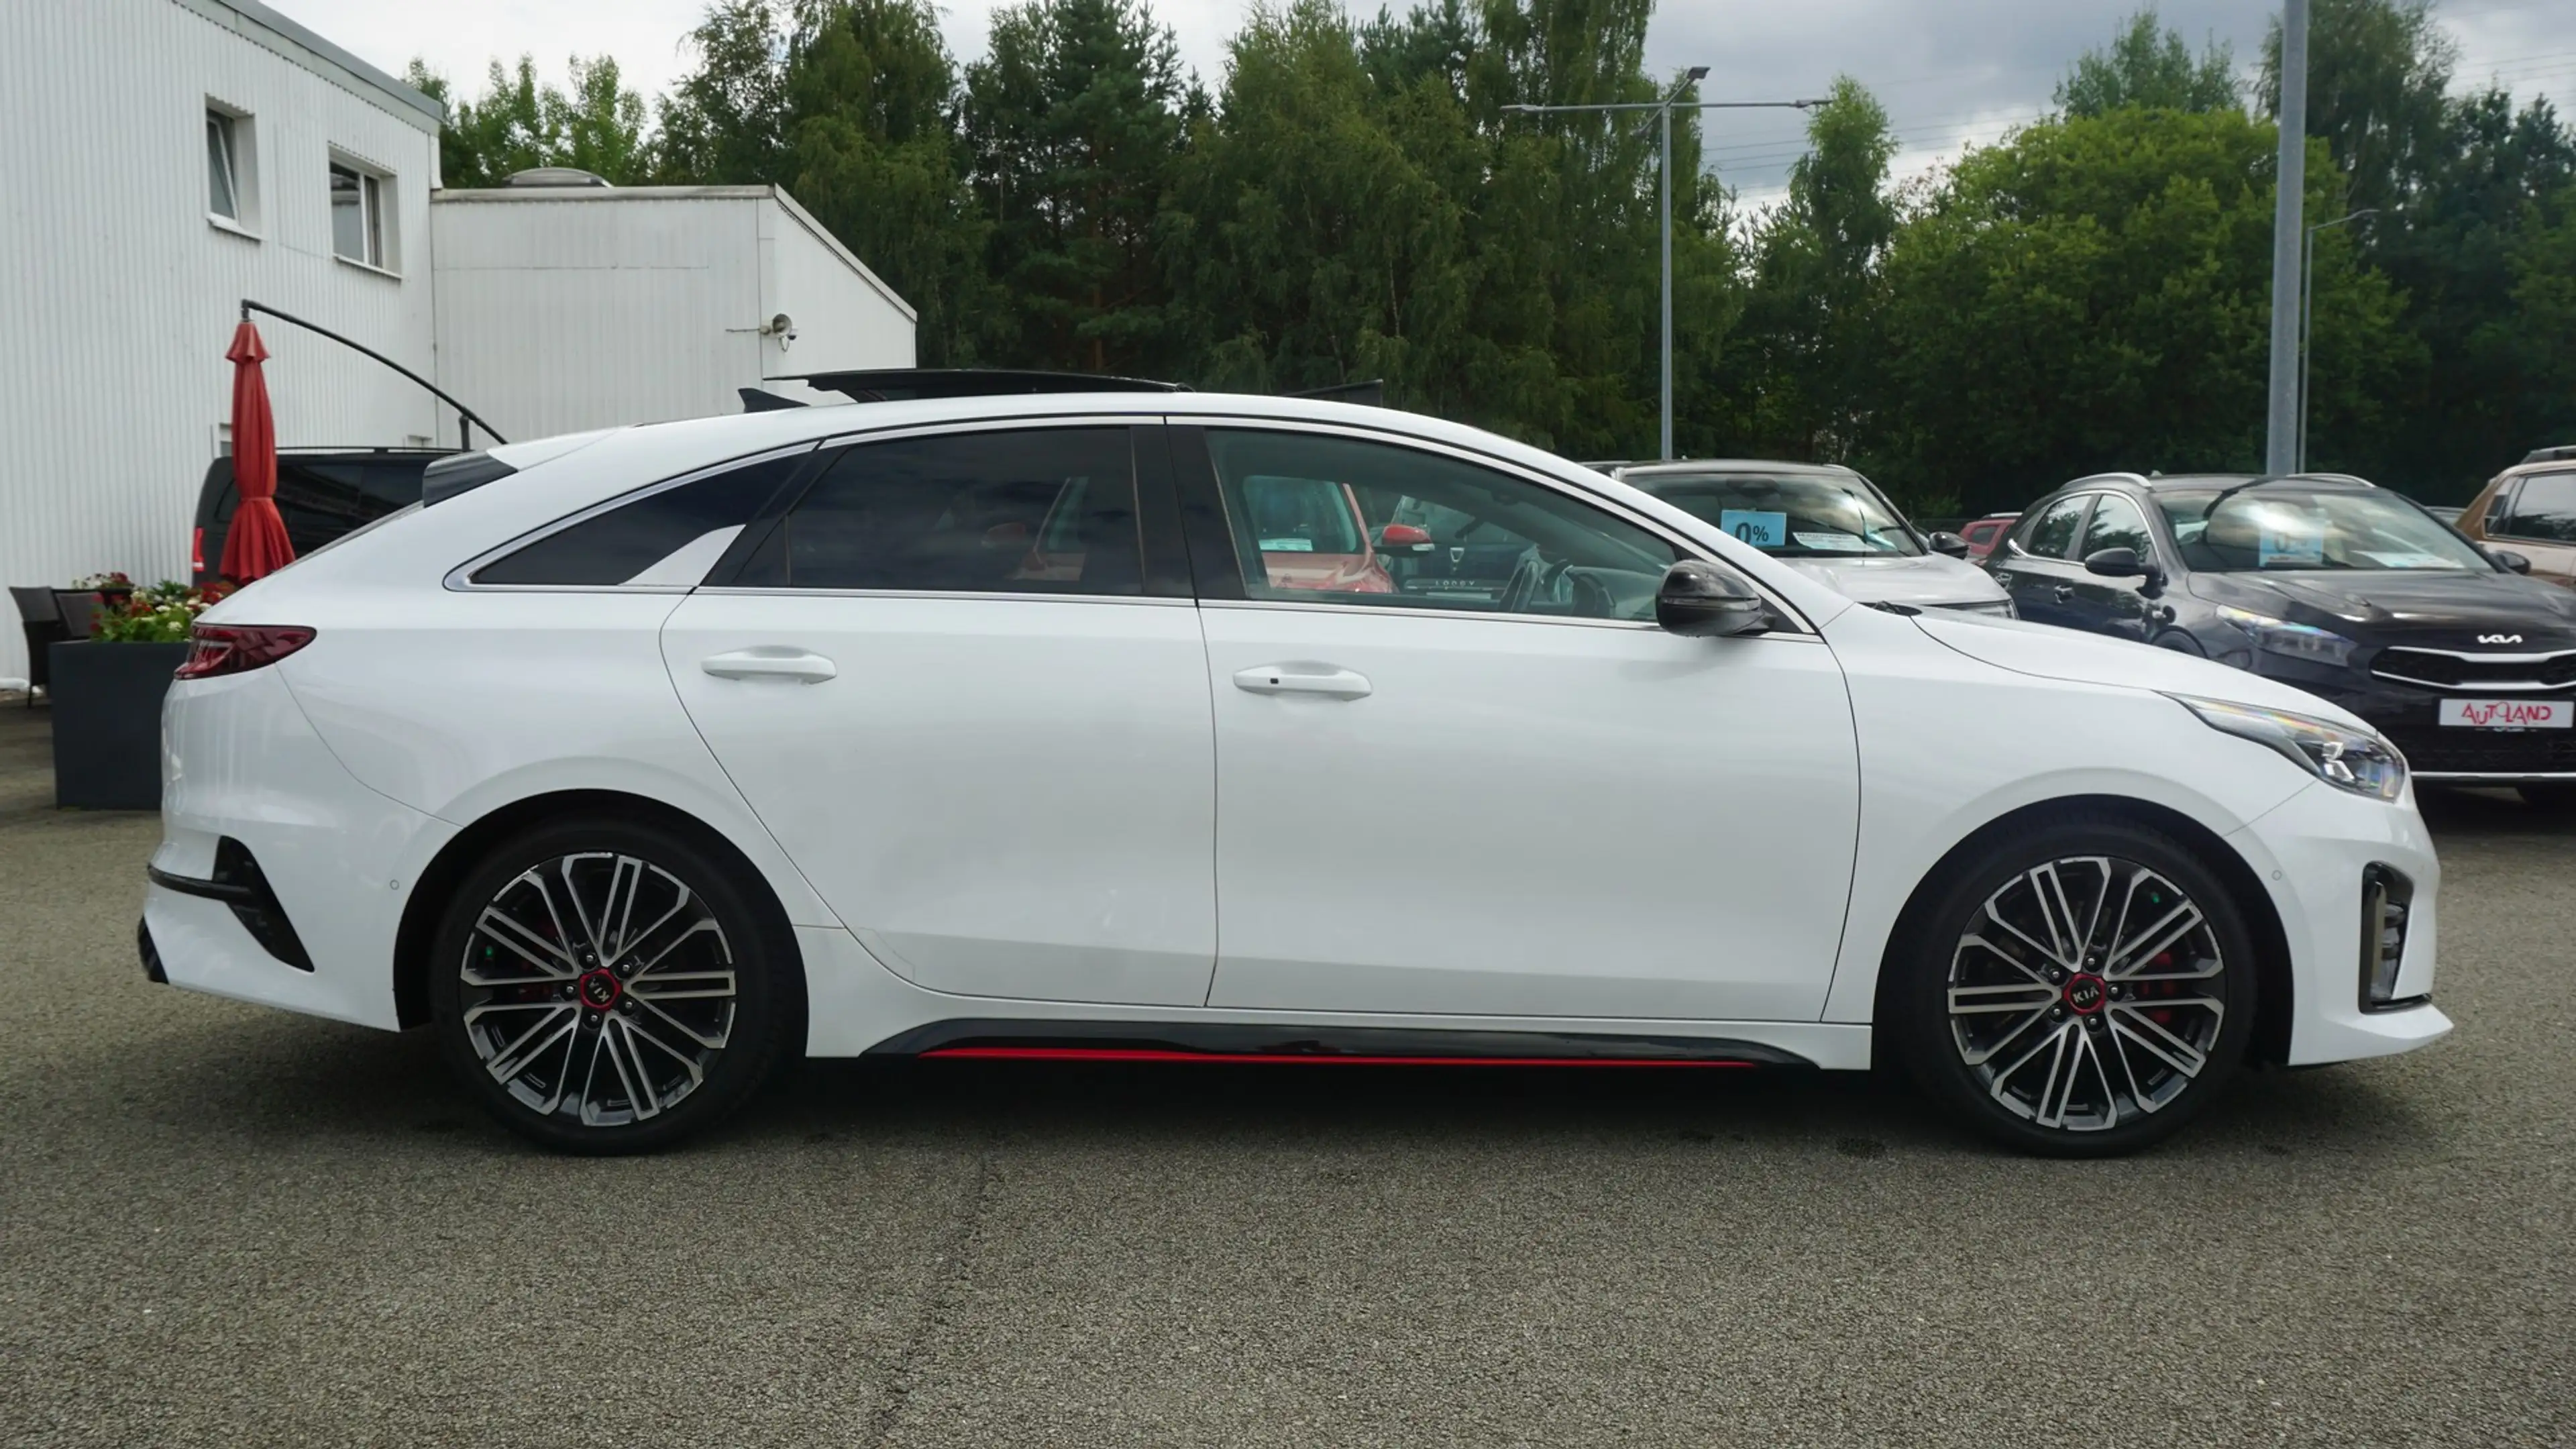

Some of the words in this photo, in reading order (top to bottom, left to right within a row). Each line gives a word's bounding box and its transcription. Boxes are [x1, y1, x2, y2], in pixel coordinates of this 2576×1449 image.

[1735, 522, 1770, 545] 0%
[588, 977, 610, 1002] KIA
[2072, 985, 2100, 1004] KIA
